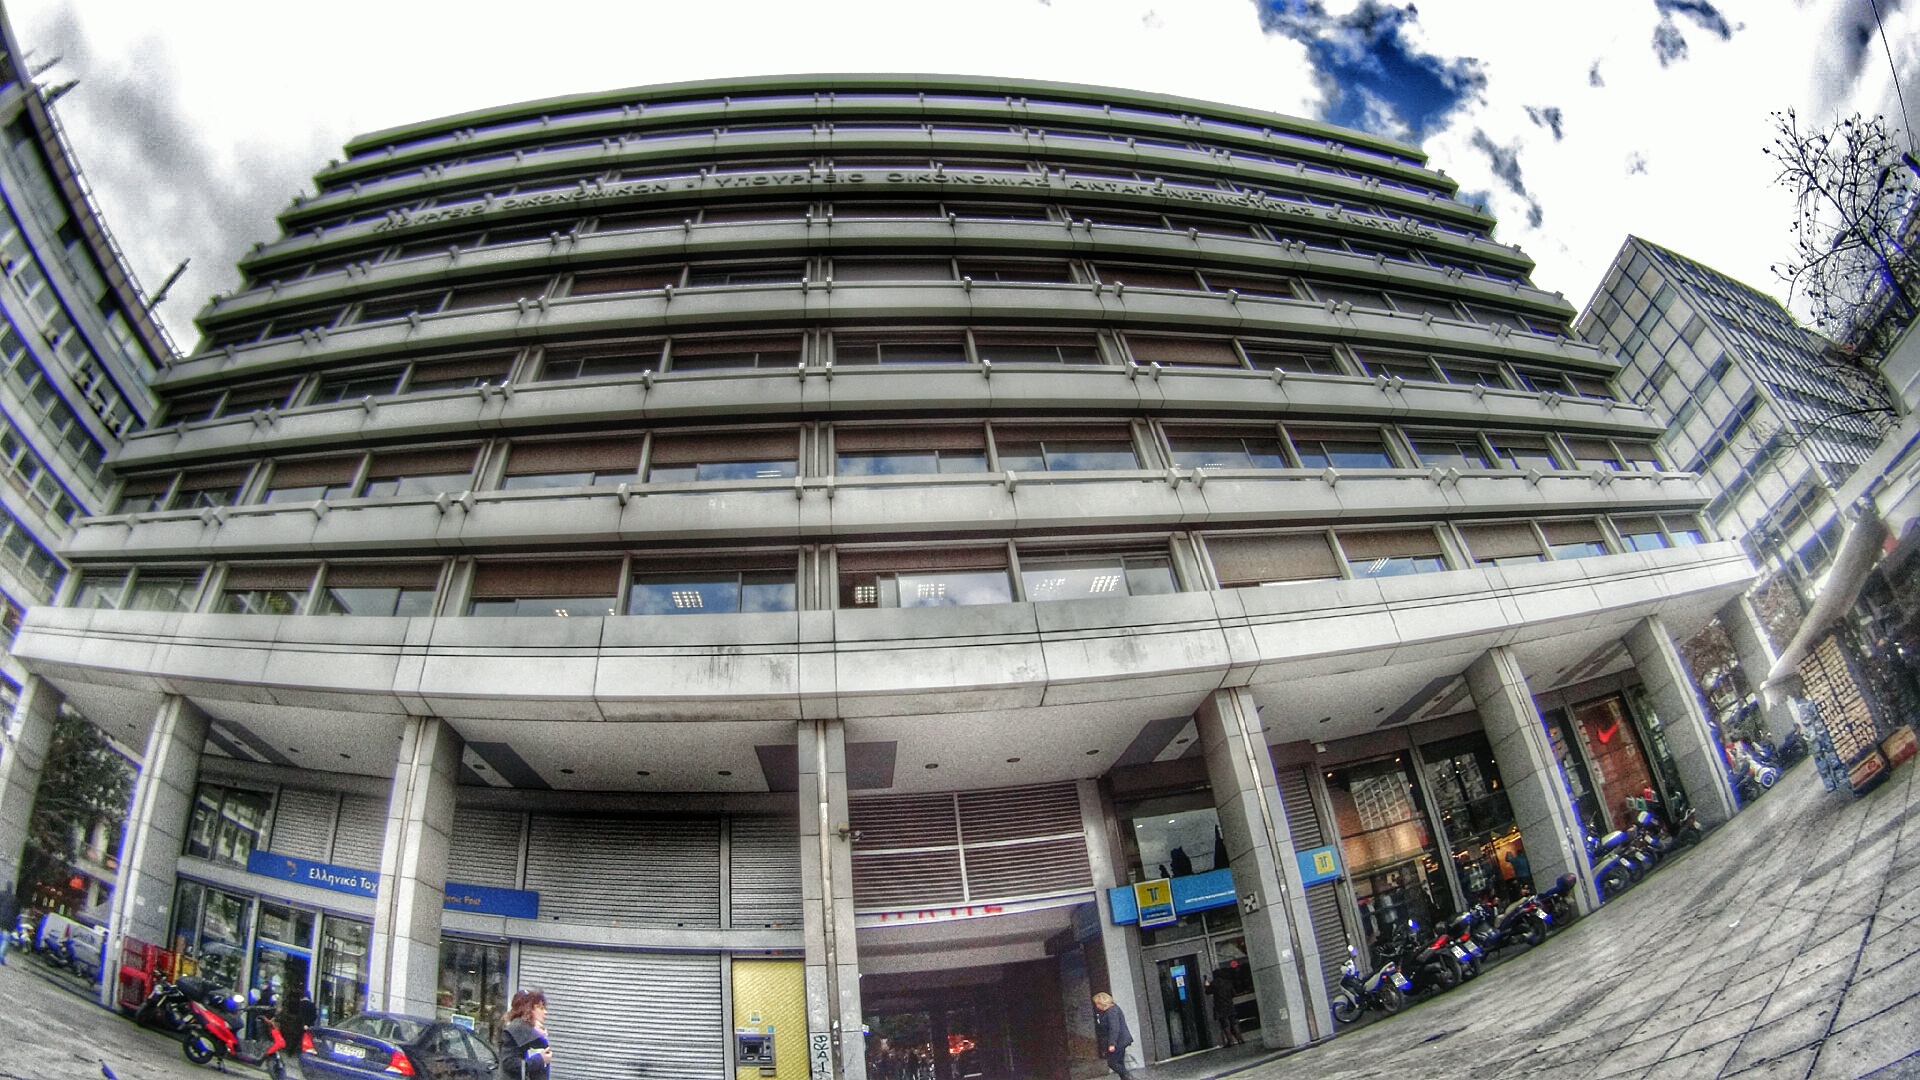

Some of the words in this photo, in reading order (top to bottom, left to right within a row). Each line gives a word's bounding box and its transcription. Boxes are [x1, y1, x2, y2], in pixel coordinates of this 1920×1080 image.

[714, 173, 865, 188] ΥΠΟΥΡΓΕΙΟ
[886, 172, 1051, 188] ΟΙΚΟΝΟΜΙΑΣ
[360, 876, 378, 894] Ταχ
